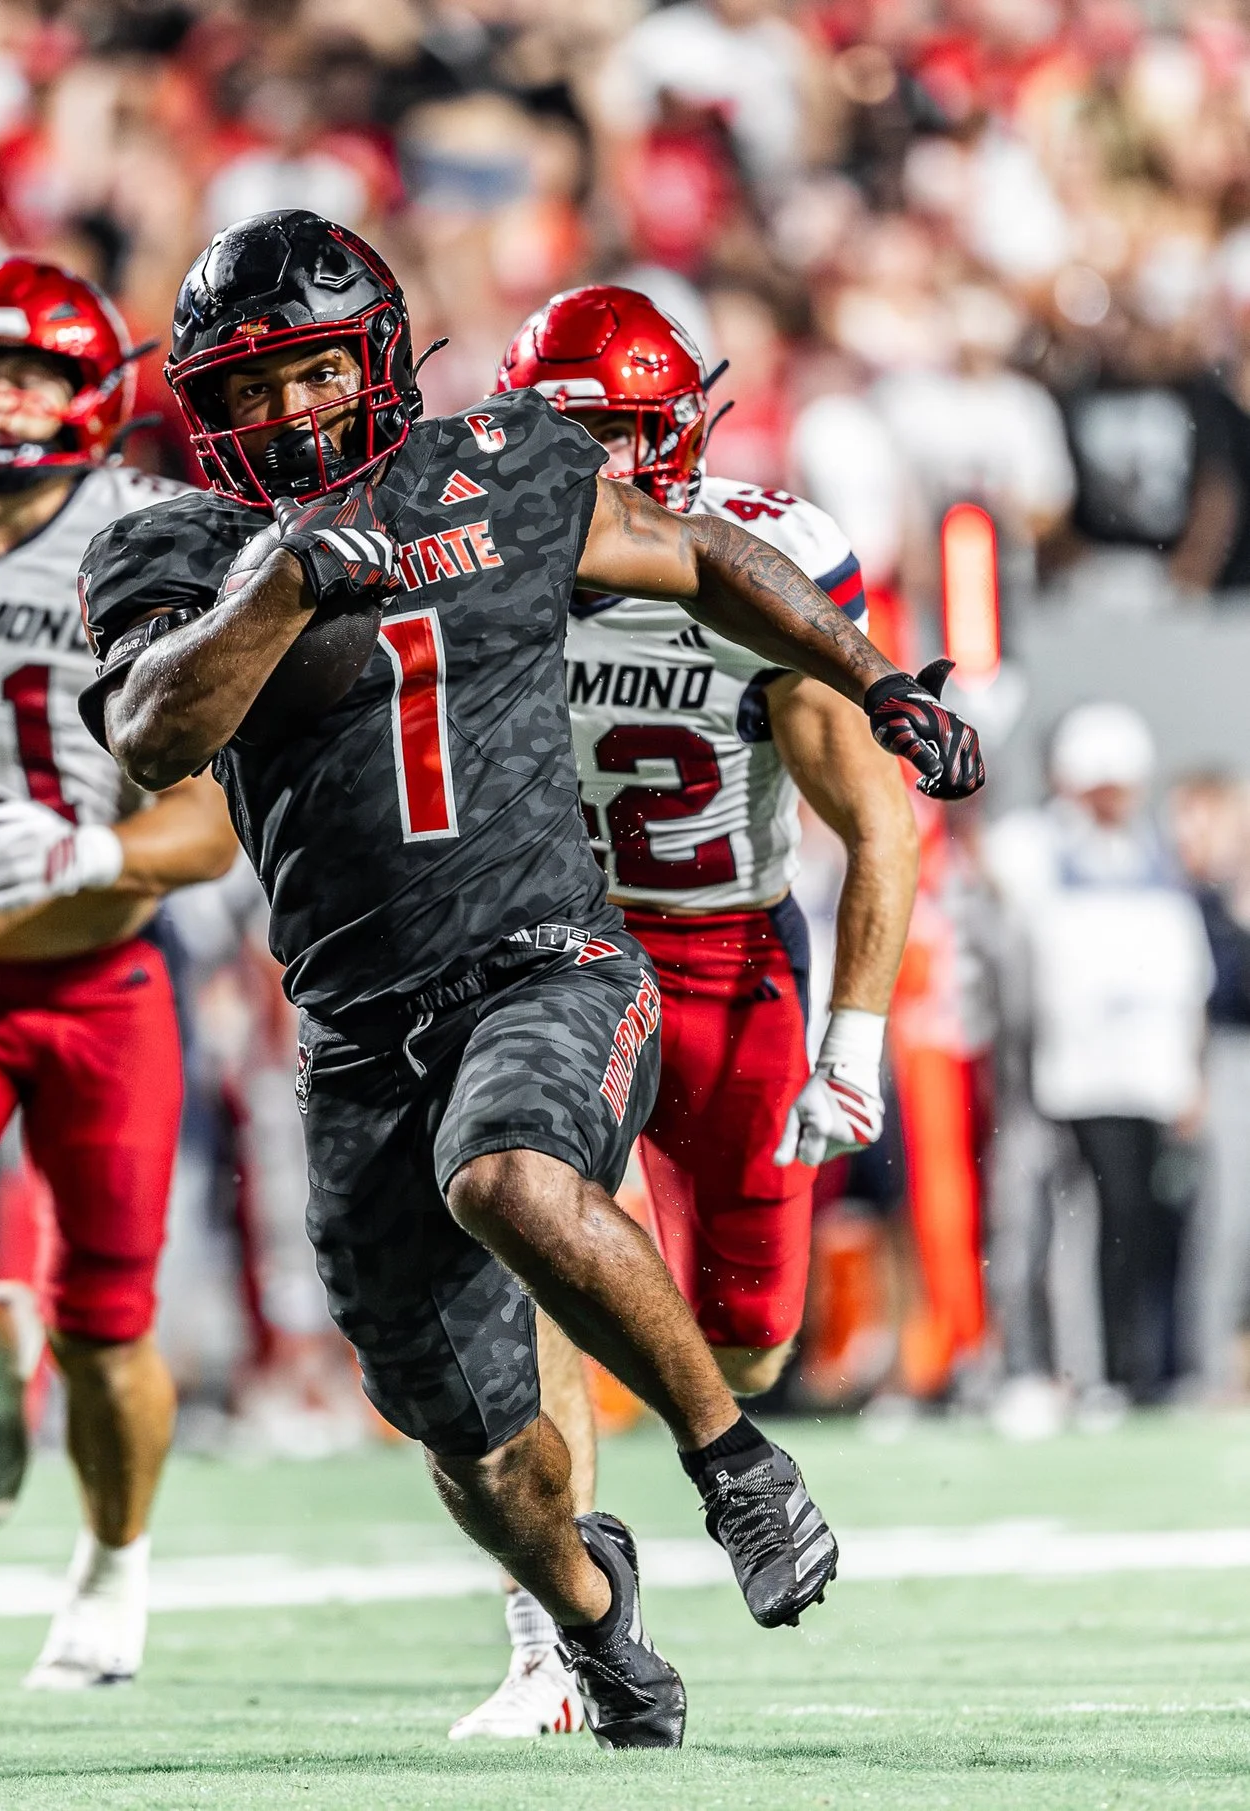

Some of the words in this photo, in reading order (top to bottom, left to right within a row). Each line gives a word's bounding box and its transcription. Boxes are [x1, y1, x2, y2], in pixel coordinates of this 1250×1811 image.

[464, 413, 507, 454] C
[398, 519, 505, 592] TATE
[564, 659, 715, 710] MOND
[376, 606, 460, 844] 1
[578, 723, 738, 890] 2
